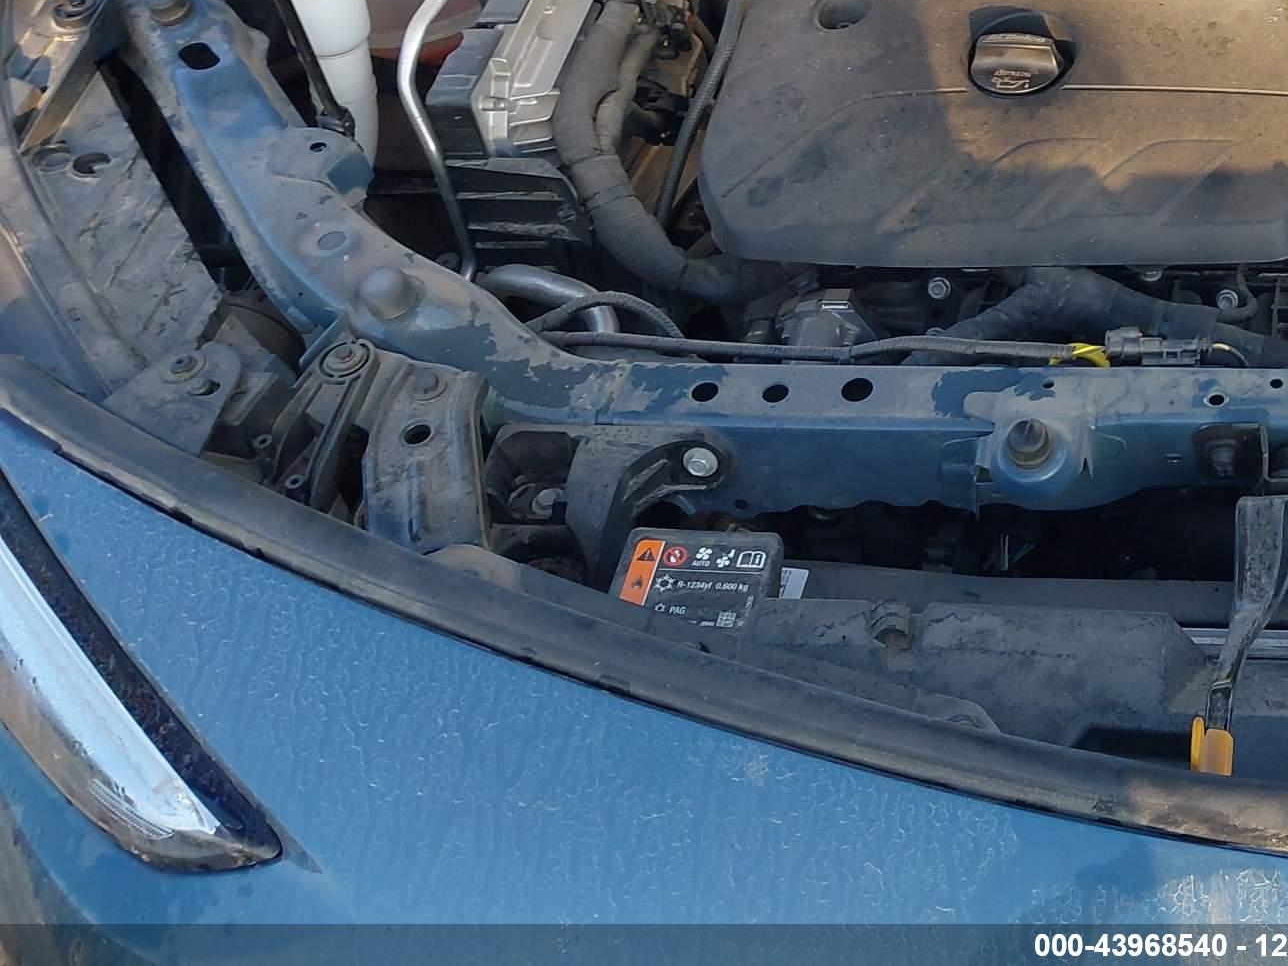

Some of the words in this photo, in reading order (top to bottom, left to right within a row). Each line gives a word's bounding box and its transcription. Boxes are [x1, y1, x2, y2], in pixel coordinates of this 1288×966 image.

[677, 581, 712, 591] R-1234yf
[738, 584, 749, 592] kg
[669, 606, 686, 615] PAG
